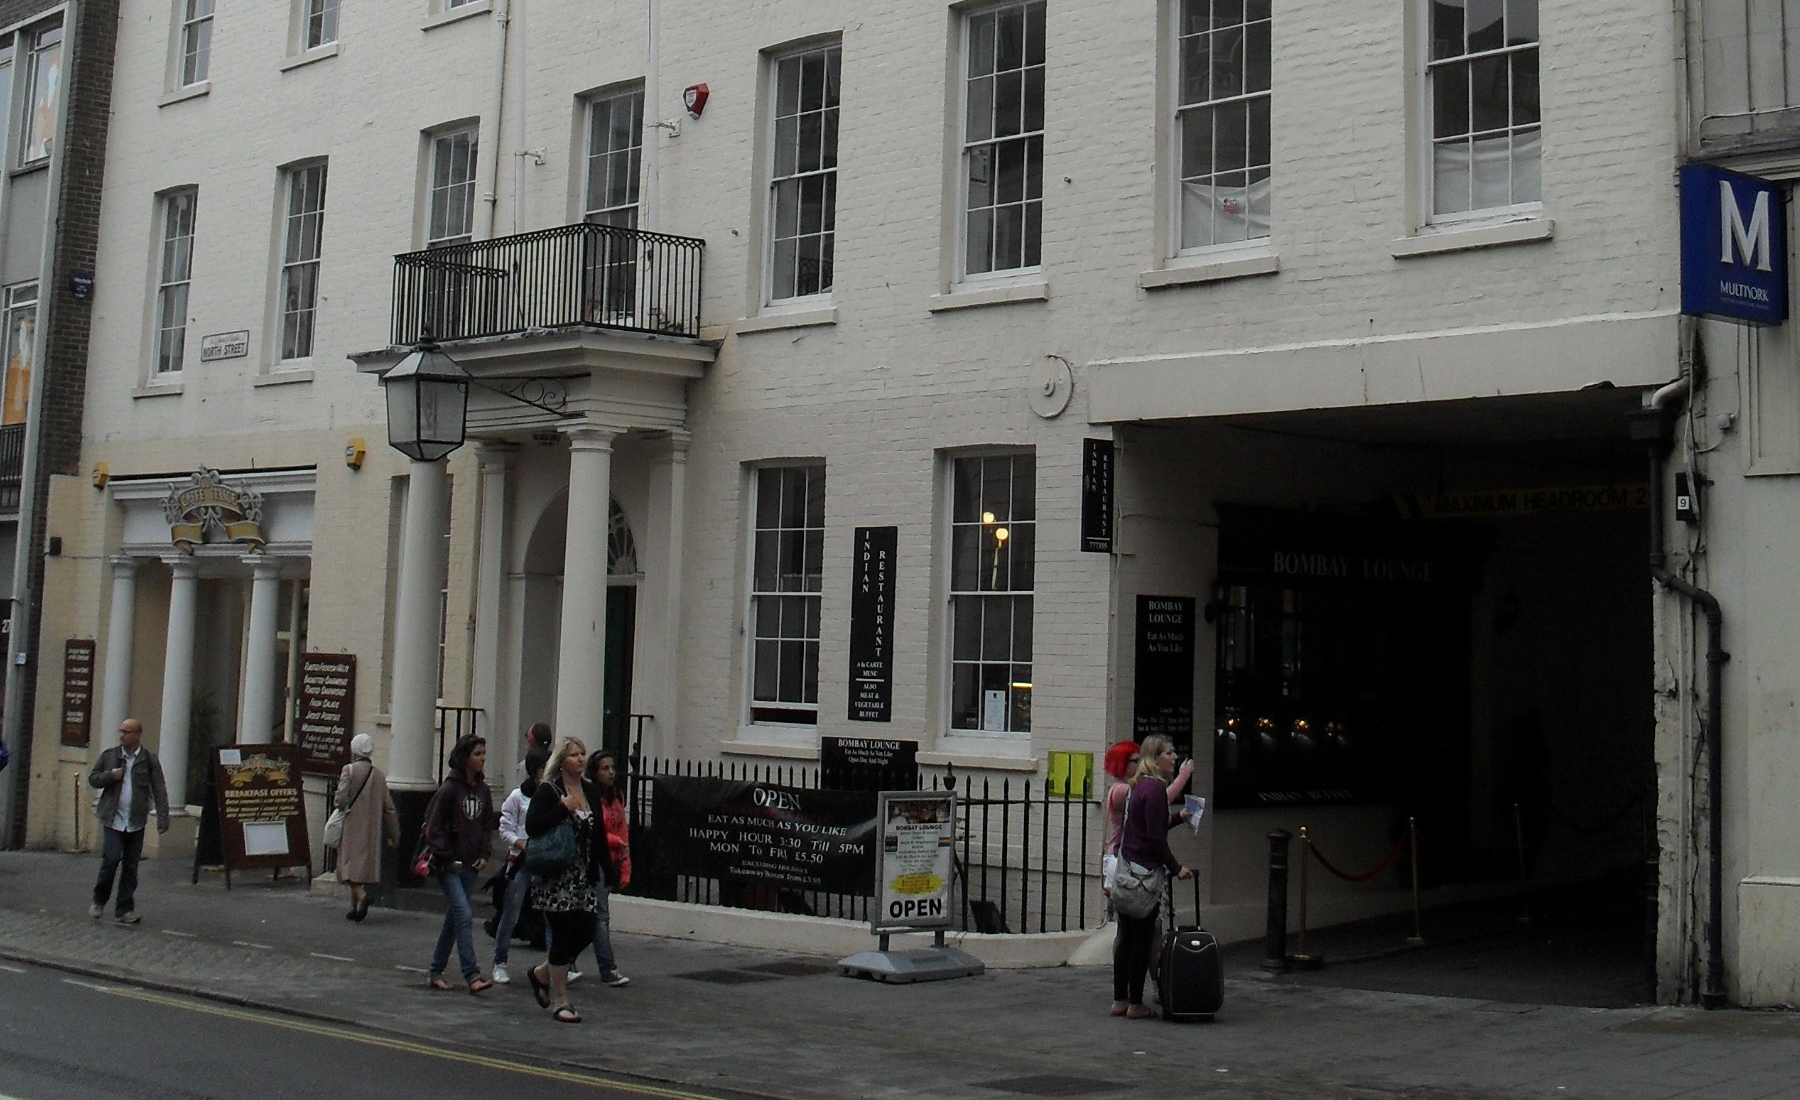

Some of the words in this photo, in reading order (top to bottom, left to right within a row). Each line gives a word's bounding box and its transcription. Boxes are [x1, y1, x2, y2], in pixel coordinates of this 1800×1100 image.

[1719, 179, 1772, 272] M
[1720, 279, 1769, 302] MULTIYORK
[224, 342, 245, 356] STREET
[1435, 493, 1517, 515] MAXIMUM
[1524, 487, 1628, 511] HEADROOM
[1680, 498, 1687, 508] 9
[862, 530, 871, 593] INDIAN
[1273, 550, 1350, 578] BOMBAY
[1362, 558, 1432, 583] LOUNGE
[875, 550, 886, 657] RESTAURANT
[1149, 600, 1184, 611] BOMBAY
[1149, 613, 1183, 624] LOUNGE
[1147, 631, 1157, 640] Eat
[1158, 631, 1166, 640] As
[1167, 631, 1184, 641] Much
[1148, 643, 1157, 652] As
[1157, 643, 1169, 652] You
[1169, 643, 1183, 652] Like
[854, 701, 884, 709] VEGETABLE
[859, 710, 879, 718] BUFFET
[838, 738, 868, 749] BOMBAY
[870, 740, 900, 750] LOUNGE
[859, 756, 867, 764] Day
[224, 789, 268, 798] BREAKFAST
[270, 787, 298, 797] OFFERS
[753, 787, 803, 811] OPEN
[1256, 790, 1304, 802] INDIAN
[708, 814, 729, 824] EAT
[730, 815, 745, 825] AS
[747, 817, 775, 828] MUCH
[777, 820, 792, 830] AS
[795, 822, 821, 834] YOU
[822, 825, 848, 837] LIKE
[689, 827, 729, 840] HAPPY
[739, 831, 773, 844] HOUR
[779, 836, 802, 848] 3:30
[810, 840, 830, 852] Till
[838, 843, 865, 855] 5PM
[709, 842, 740, 854] MON
[748, 844, 763, 855] To
[769, 847, 787, 860] FRI
[794, 852, 824, 865] £5.50
[786, 873, 802, 882] from
[889, 898, 942, 919] OPEN
